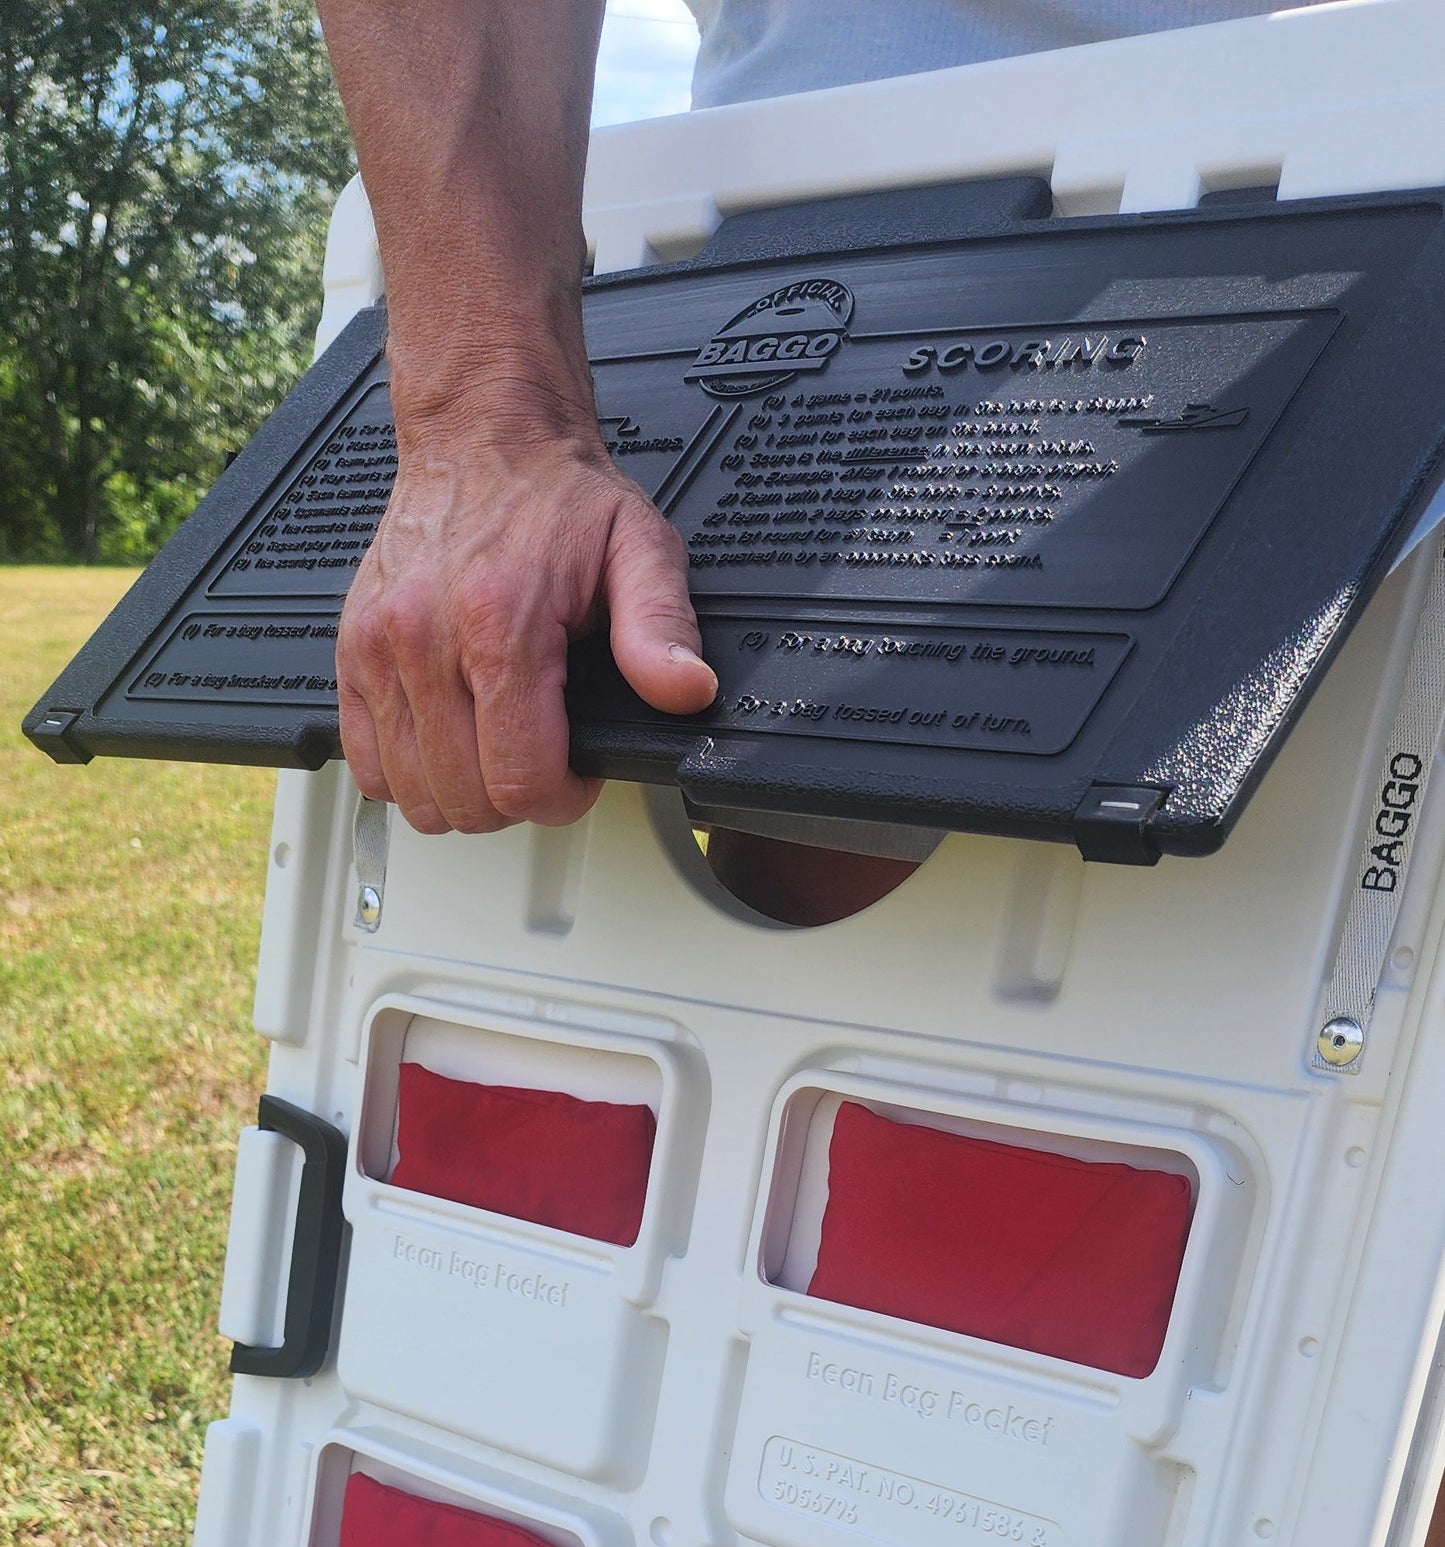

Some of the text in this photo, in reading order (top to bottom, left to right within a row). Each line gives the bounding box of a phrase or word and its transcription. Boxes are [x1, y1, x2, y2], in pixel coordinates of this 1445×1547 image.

[692, 333, 841, 367] BAGGO
[902, 336, 1147, 375] SCORING
[793, 410, 845, 430] points
[847, 408, 873, 424] for
[874, 406, 916, 423] each
[918, 404, 951, 420] bag
[953, 404, 971, 417] in
[806, 392, 851, 409] game
[776, 431, 818, 449] point
[820, 430, 845, 445] for
[846, 427, 887, 444] each
[889, 425, 922, 443] bag
[925, 425, 948, 437] on
[750, 453, 796, 468] Score
[816, 449, 842, 465] the
[843, 446, 929, 463] difference
[740, 490, 783, 505] Team
[831, 488, 866, 504] bag
[727, 510, 771, 525] Team
[824, 508, 868, 524] bags
[762, 530, 814, 546] round
[814, 529, 842, 544] for
[793, 551, 818, 568] by
[738, 631, 1095, 667] (3) For a bag touching the ground.
[734, 695, 769, 711] For
[771, 700, 787, 714] a
[790, 699, 829, 720] bag
[832, 702, 901, 724] tossed
[909, 709, 946, 728] out
[952, 711, 983, 730] of
[983, 714, 1031, 735] turn.
[1361, 751, 1422, 894] BAGGO
[392, 1234, 569, 1308] Bean Bag Pocket
[806, 1351, 1055, 1447] Bean Bag Pocket
[774, 1480, 858, 1525] 5056796
[779, 1445, 798, 1471] U.
[803, 1453, 820, 1478] S.
[826, 1460, 870, 1494] PAT.
[876, 1475, 919, 1510] NO.
[926, 1493, 1024, 1542] 4961586
